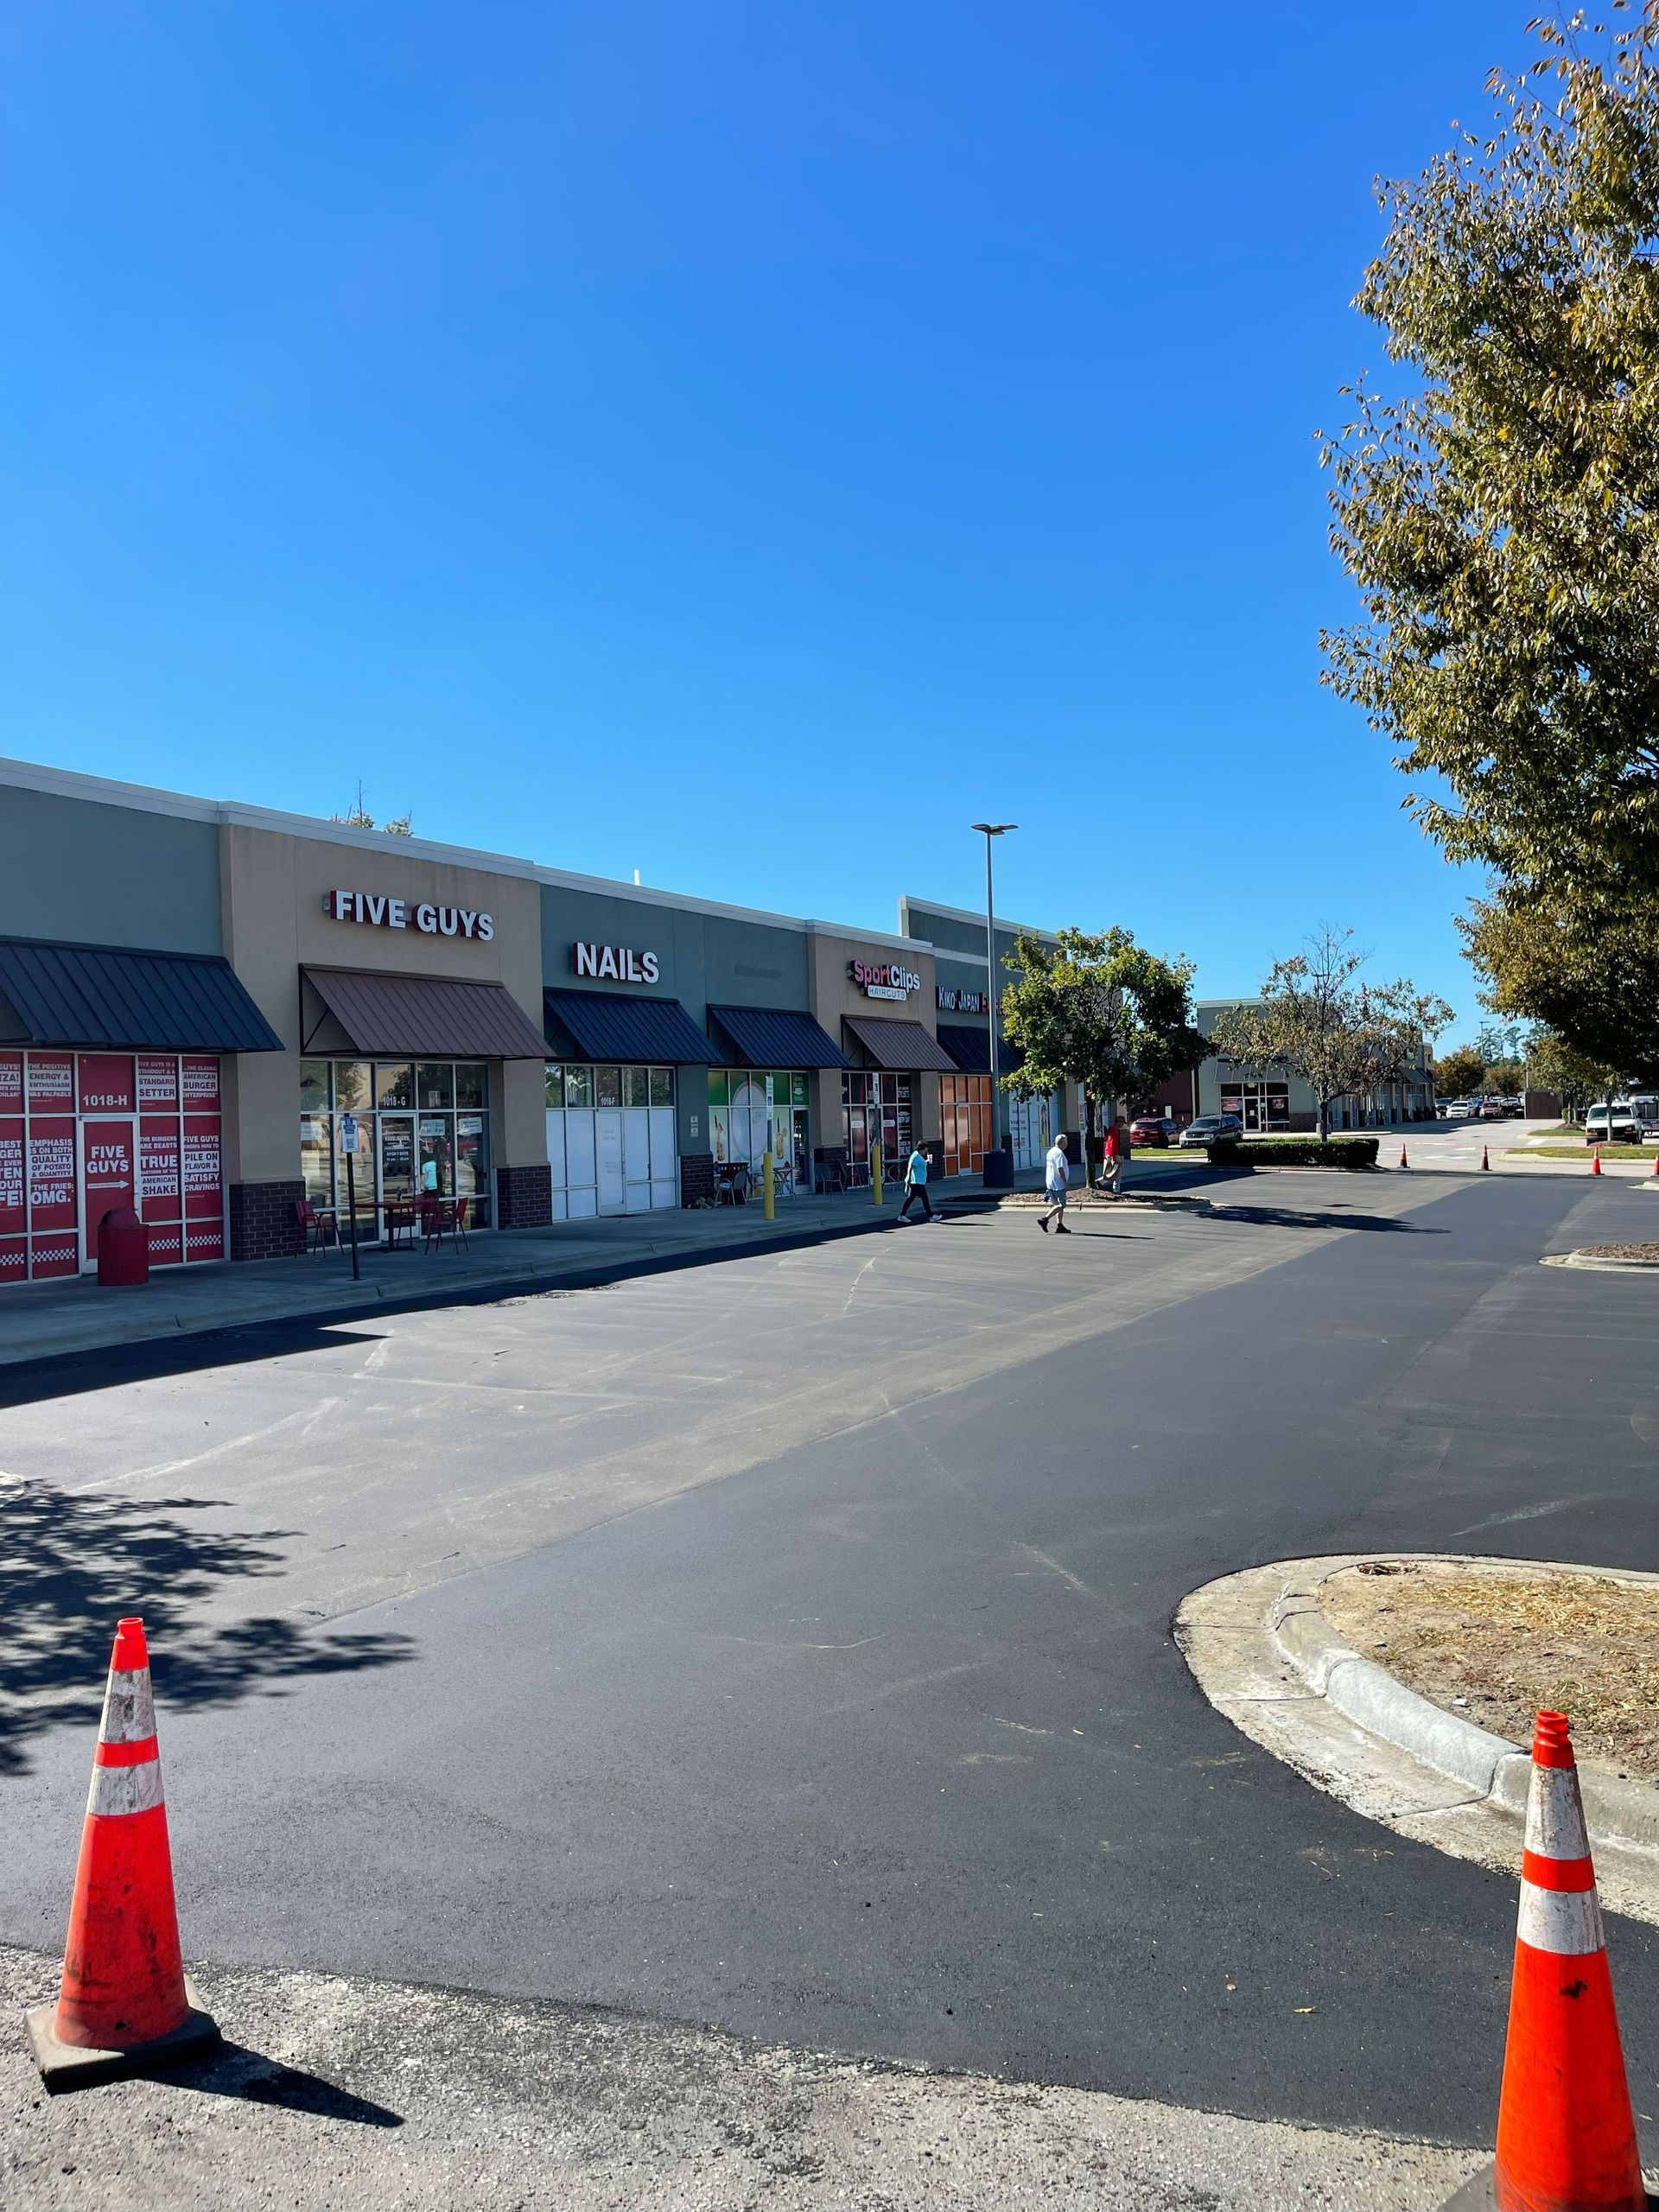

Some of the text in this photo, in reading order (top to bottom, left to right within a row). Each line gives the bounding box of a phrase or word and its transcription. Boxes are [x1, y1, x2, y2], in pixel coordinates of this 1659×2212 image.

[335, 890, 494, 942] FIVE GUYS
[576, 942, 659, 984] NAILS
[869, 988, 906, 999] HAIRCUTS
[938, 986, 956, 1010] KIKO
[959, 989, 980, 1012] JAPAN
[82, 1095, 128, 1106] 1018-H
[30, 1139, 73, 1147] EMPHASIS
[91, 1146, 124, 1159] FIVE
[185, 1153, 203, 1161] PILE
[32, 1155, 70, 1164] QUALITY
[140, 1154, 178, 1169] TRUE
[87, 1160, 129, 1173] GUYS
[184, 1173, 219, 1182] SATISFY
[143, 1185, 176, 1195] SHAKE
[185, 1183, 219, 1192] CRAVINGS
